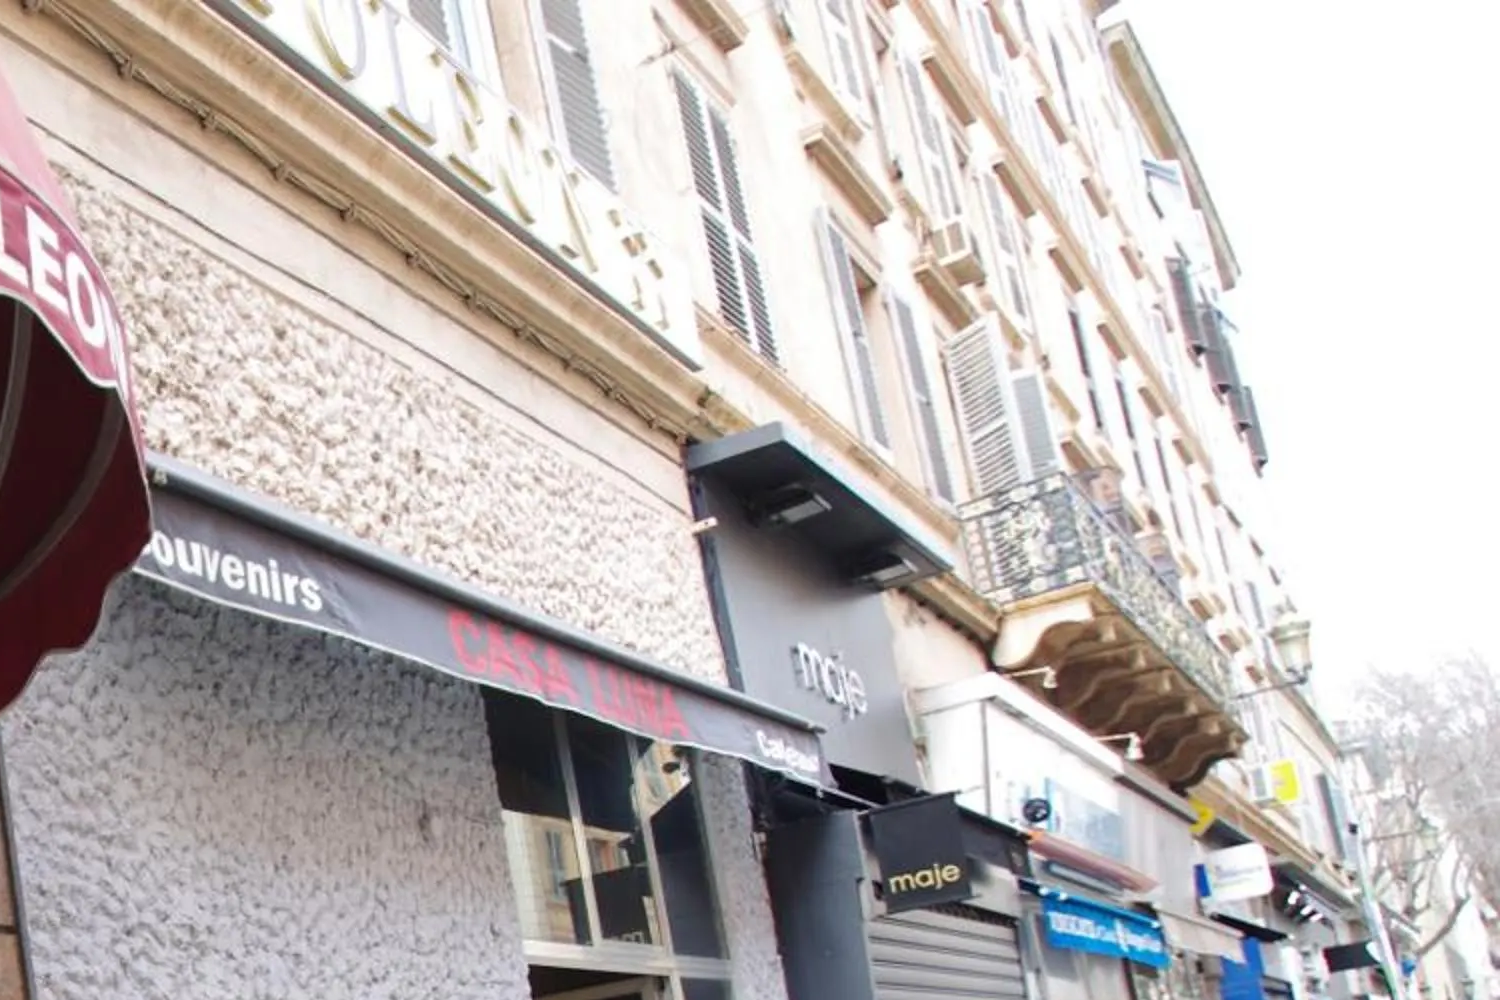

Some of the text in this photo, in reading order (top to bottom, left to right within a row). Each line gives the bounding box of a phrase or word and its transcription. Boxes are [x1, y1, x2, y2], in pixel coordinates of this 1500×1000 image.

[140, 529, 322, 613] ouvenirs
[447, 604, 693, 738] CASA LUNA
[796, 641, 868, 721] maje
[888, 863, 961, 894] maje
